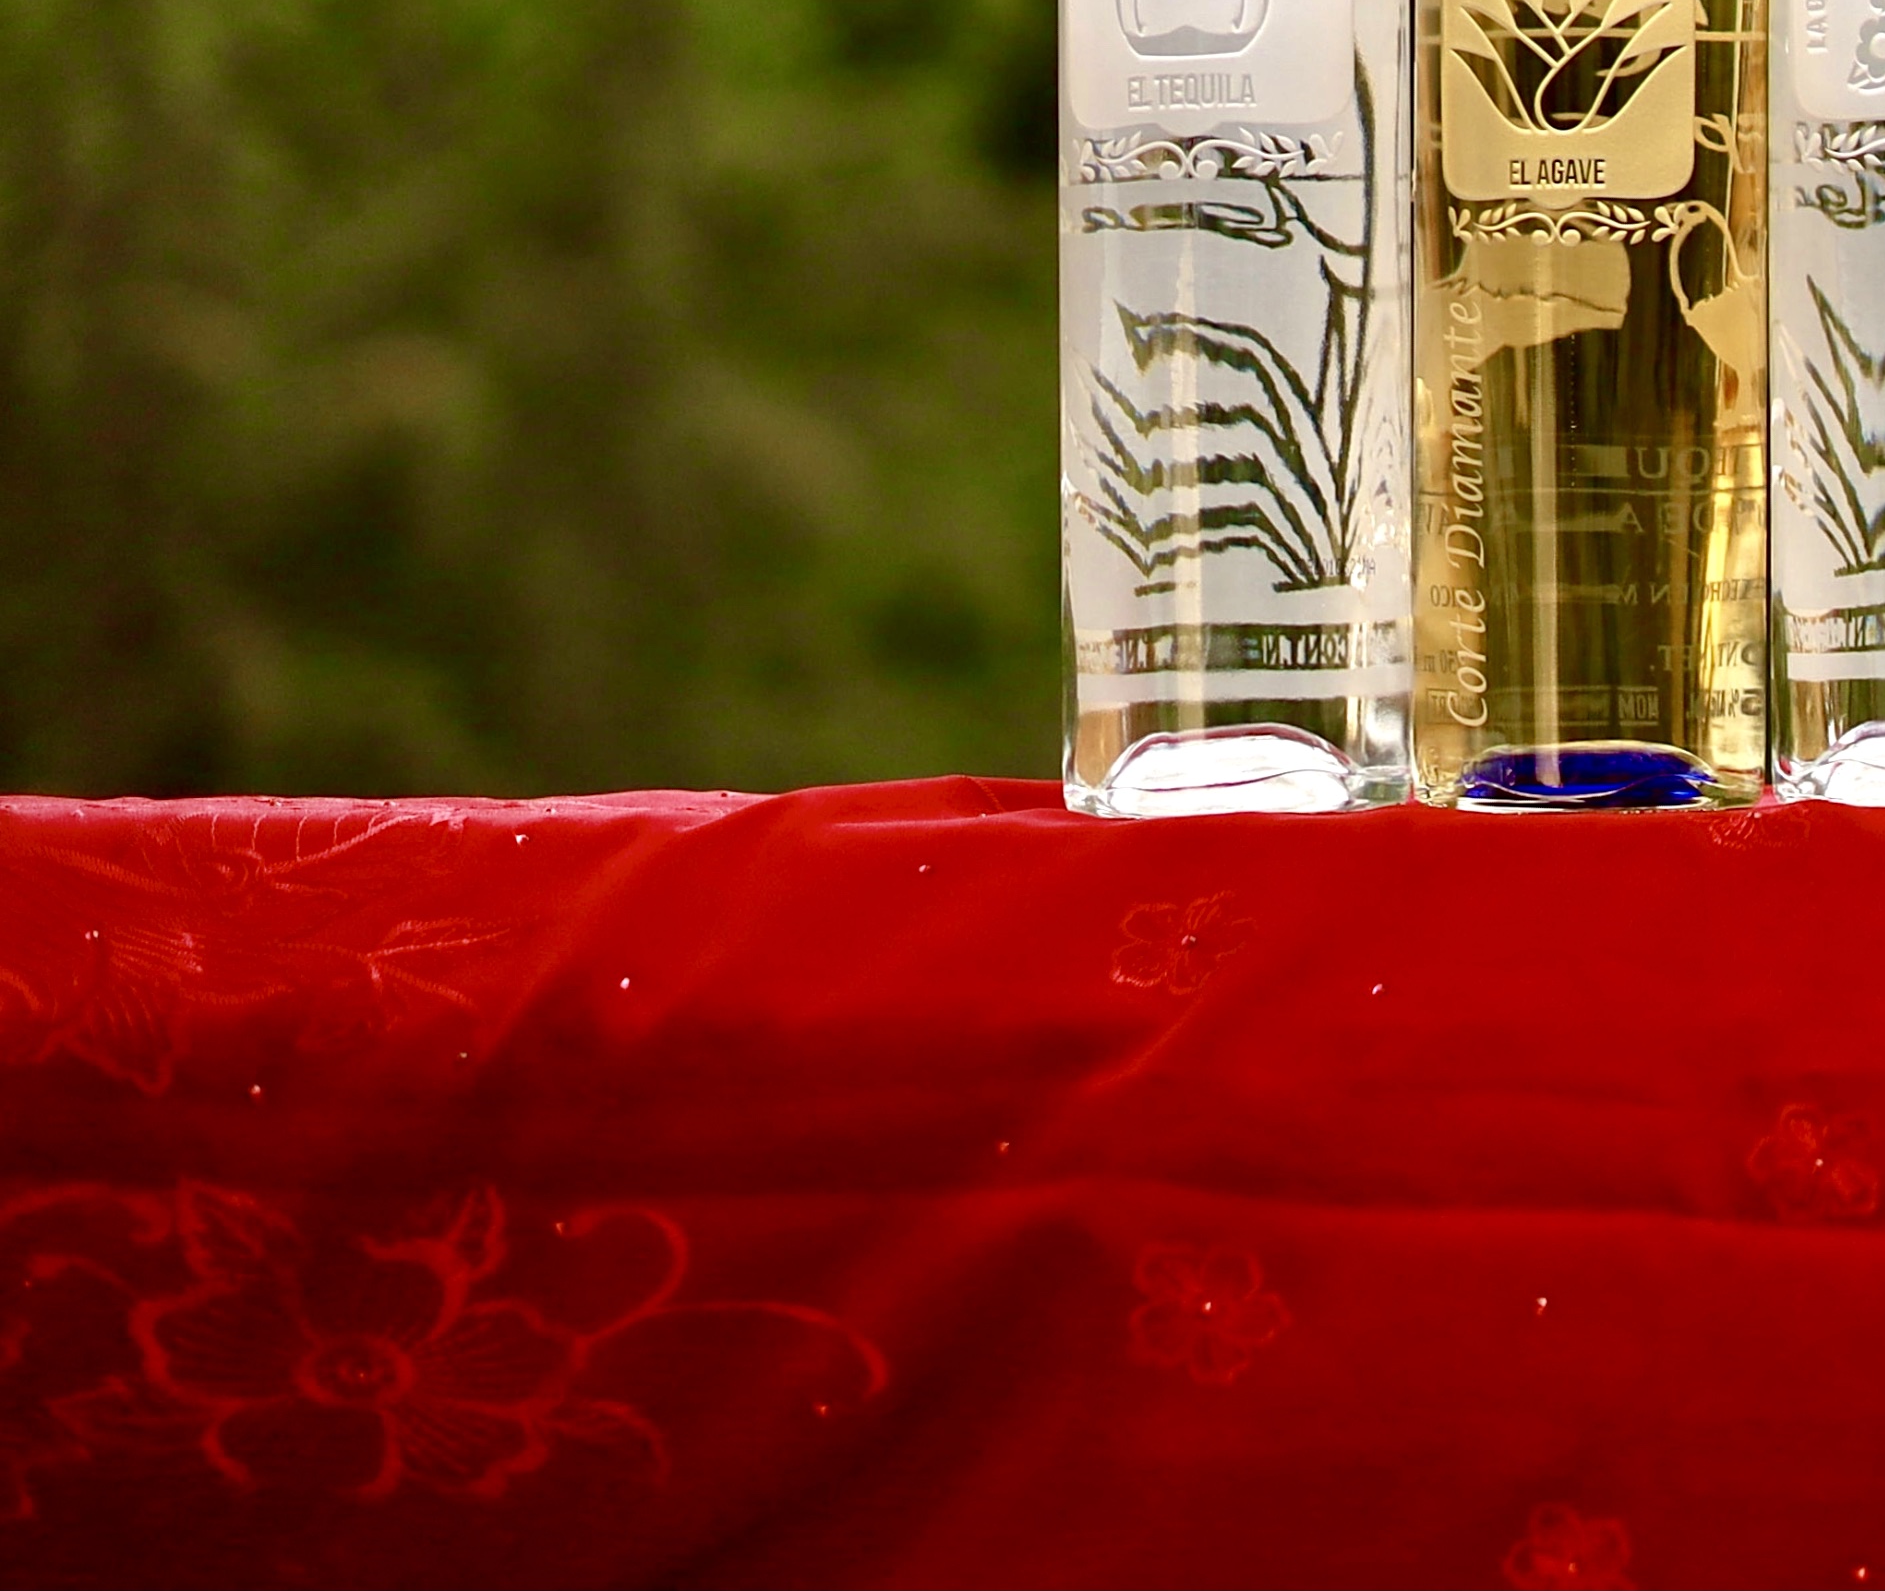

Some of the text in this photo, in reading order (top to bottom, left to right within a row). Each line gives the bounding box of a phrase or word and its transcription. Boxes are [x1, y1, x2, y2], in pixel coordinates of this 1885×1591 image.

[1806, 15, 1828, 53] LA
[1127, 72, 1258, 110] EL TEQUILA
[1508, 159, 1607, 190] EL AGAVE
[1448, 587, 1489, 728] Corte
